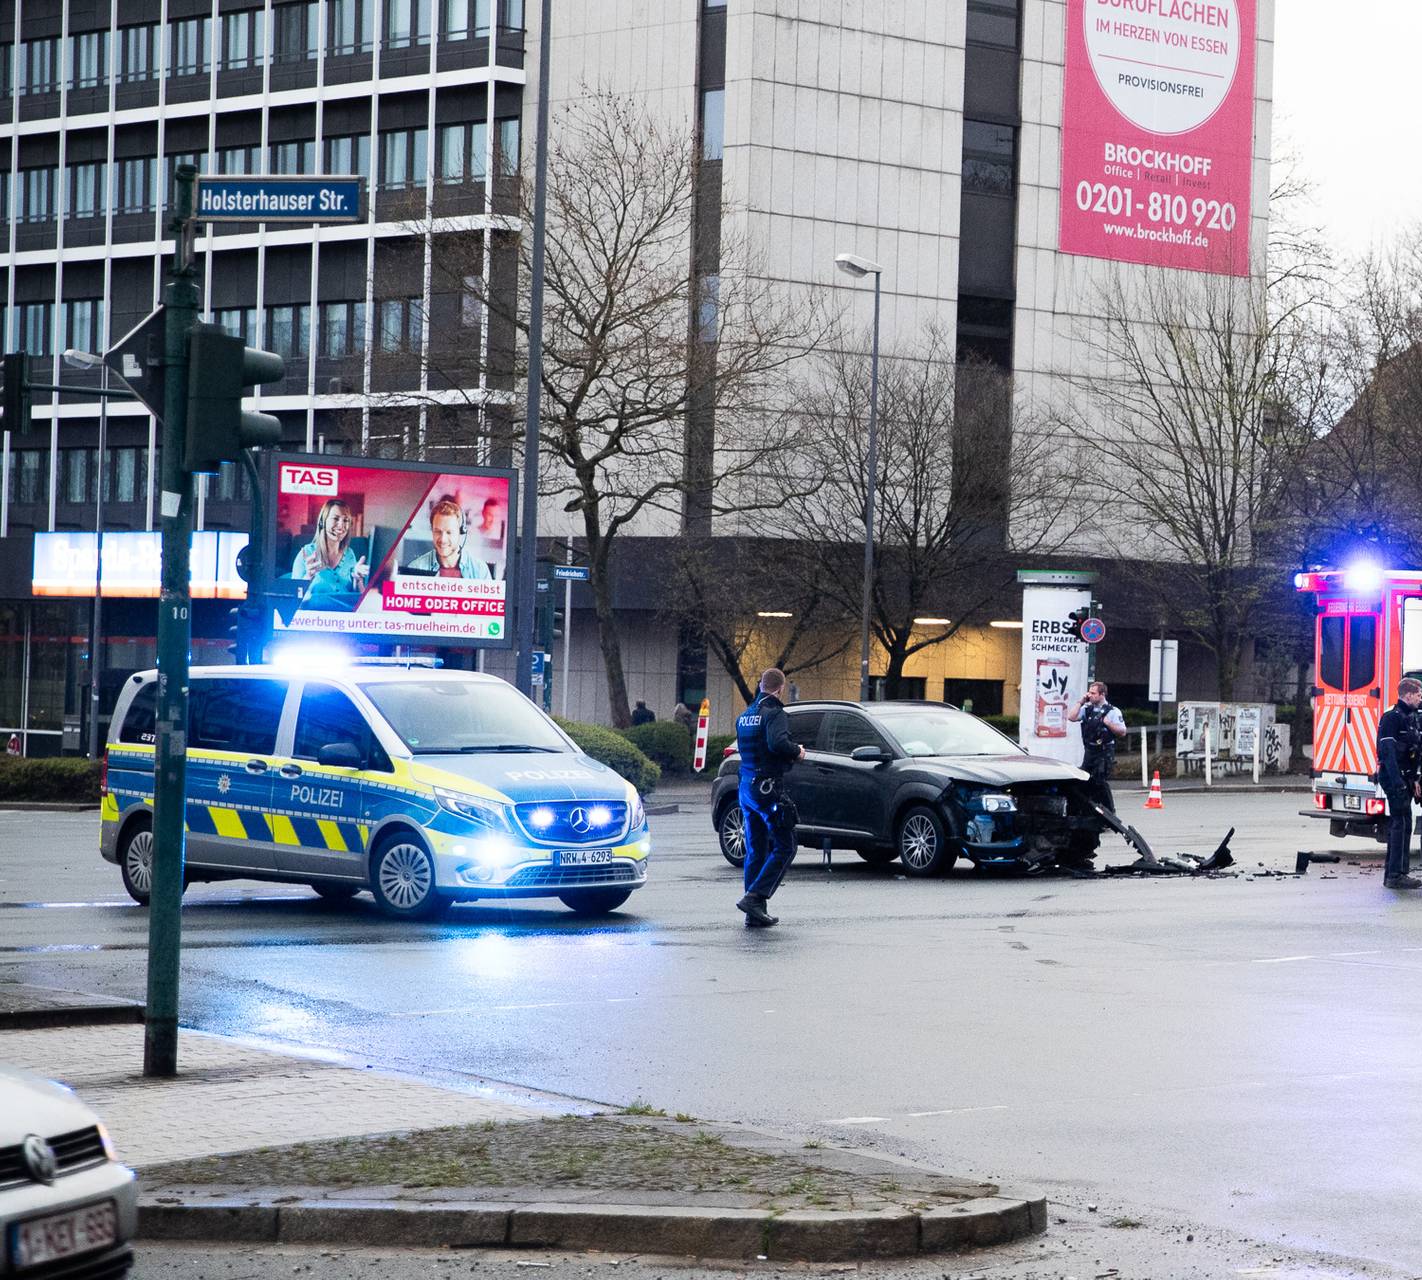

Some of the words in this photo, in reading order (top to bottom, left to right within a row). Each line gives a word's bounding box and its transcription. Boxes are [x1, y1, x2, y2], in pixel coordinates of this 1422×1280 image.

[1096, 18, 1110, 34] IM
[1114, 21, 1160, 44] HERZEN
[1164, 31, 1188, 49] VON
[1191, 36, 1228, 55] ESSEN
[1118, 73, 1204, 98] PROVISIONSFREI
[1104, 142, 1212, 177] BROCKHOFF
[1104, 164, 1133, 179] Office
[1144, 171, 1172, 185] Retail
[201, 188, 315, 211] Holsterhauser
[319, 188, 348, 211] Str.
[1103, 221, 1209, 248] www.brockhoff.de
[286, 469, 333, 486] TAS
[402, 581, 463, 593] entscheide
[467, 583, 501, 594] selbst
[386, 597, 421, 610] HOME
[424, 599, 458, 611] ODER
[461, 600, 505, 613] OFFICE
[282, 615, 346, 630] ewerbung
[348, 619, 383, 631] unter:
[384, 620, 476, 634] tas-muelheim.de
[1031, 635, 1053, 643] STATT
[738, 715, 762, 727] POLIZEI
[290, 784, 344, 809] POLIZEI
[560, 851, 577, 865] NRW
